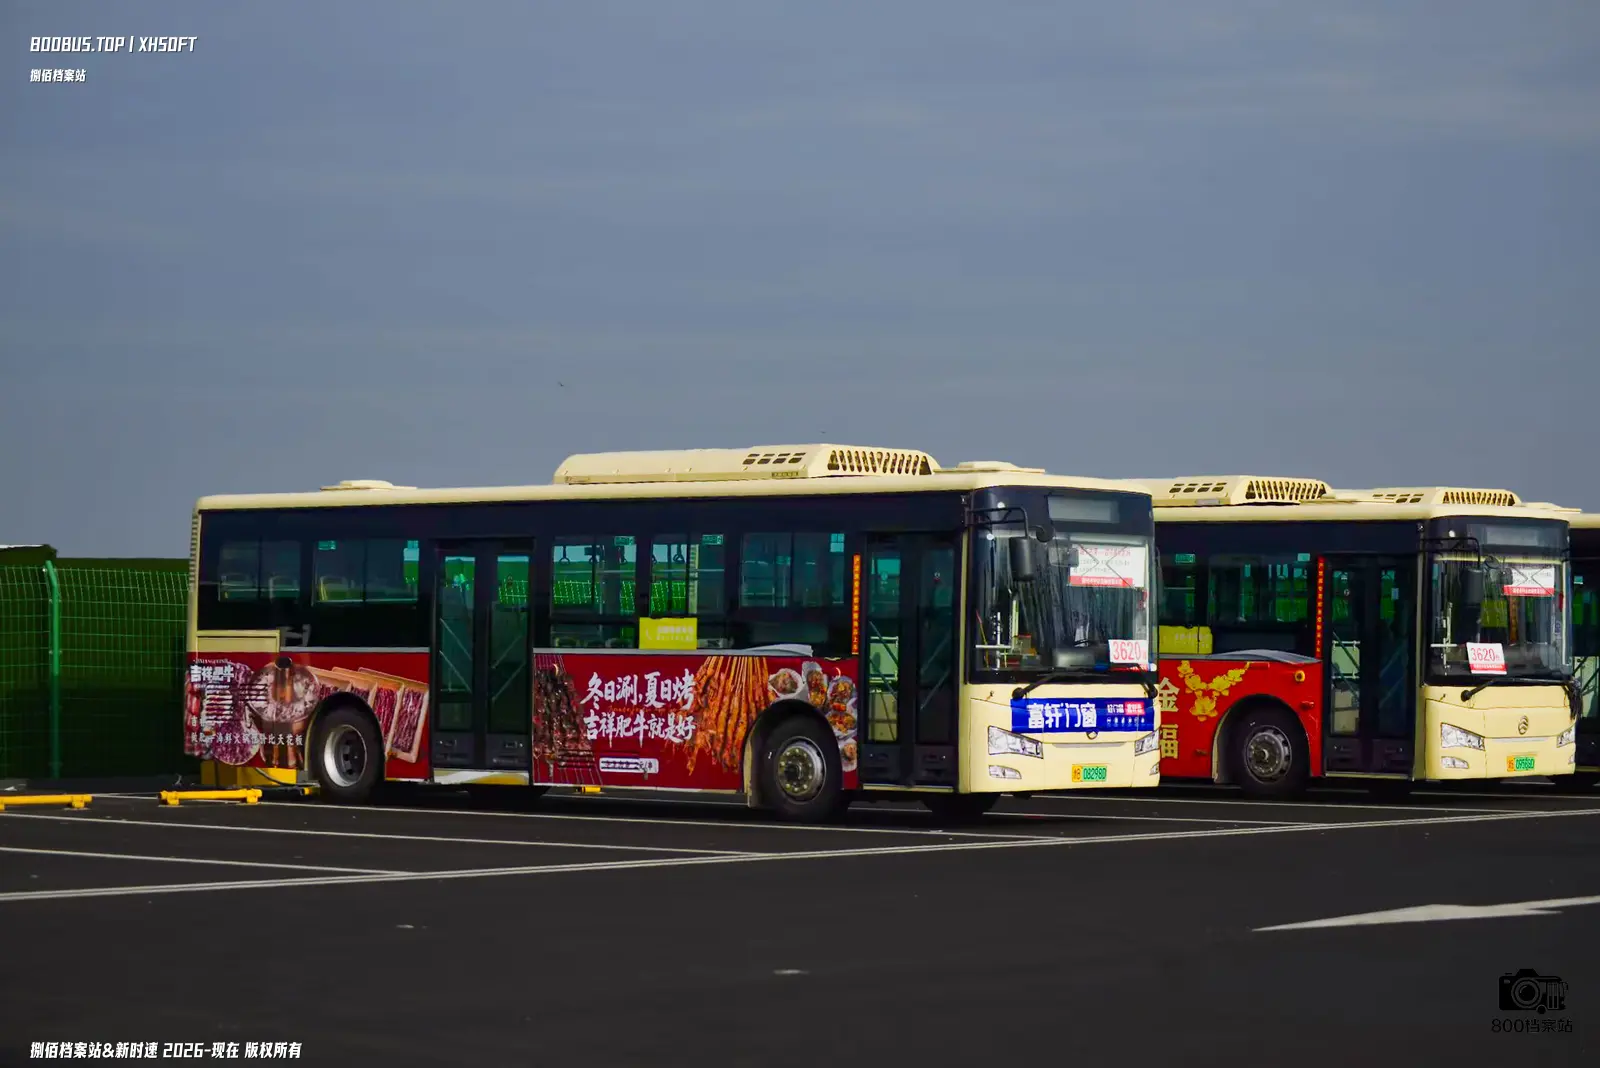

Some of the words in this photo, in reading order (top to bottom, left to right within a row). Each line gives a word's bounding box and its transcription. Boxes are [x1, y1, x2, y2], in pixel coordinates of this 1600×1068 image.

[583, 709, 697, 749] 吉祥肥牛就是好
[1026, 702, 1097, 728] 富轩门窗
